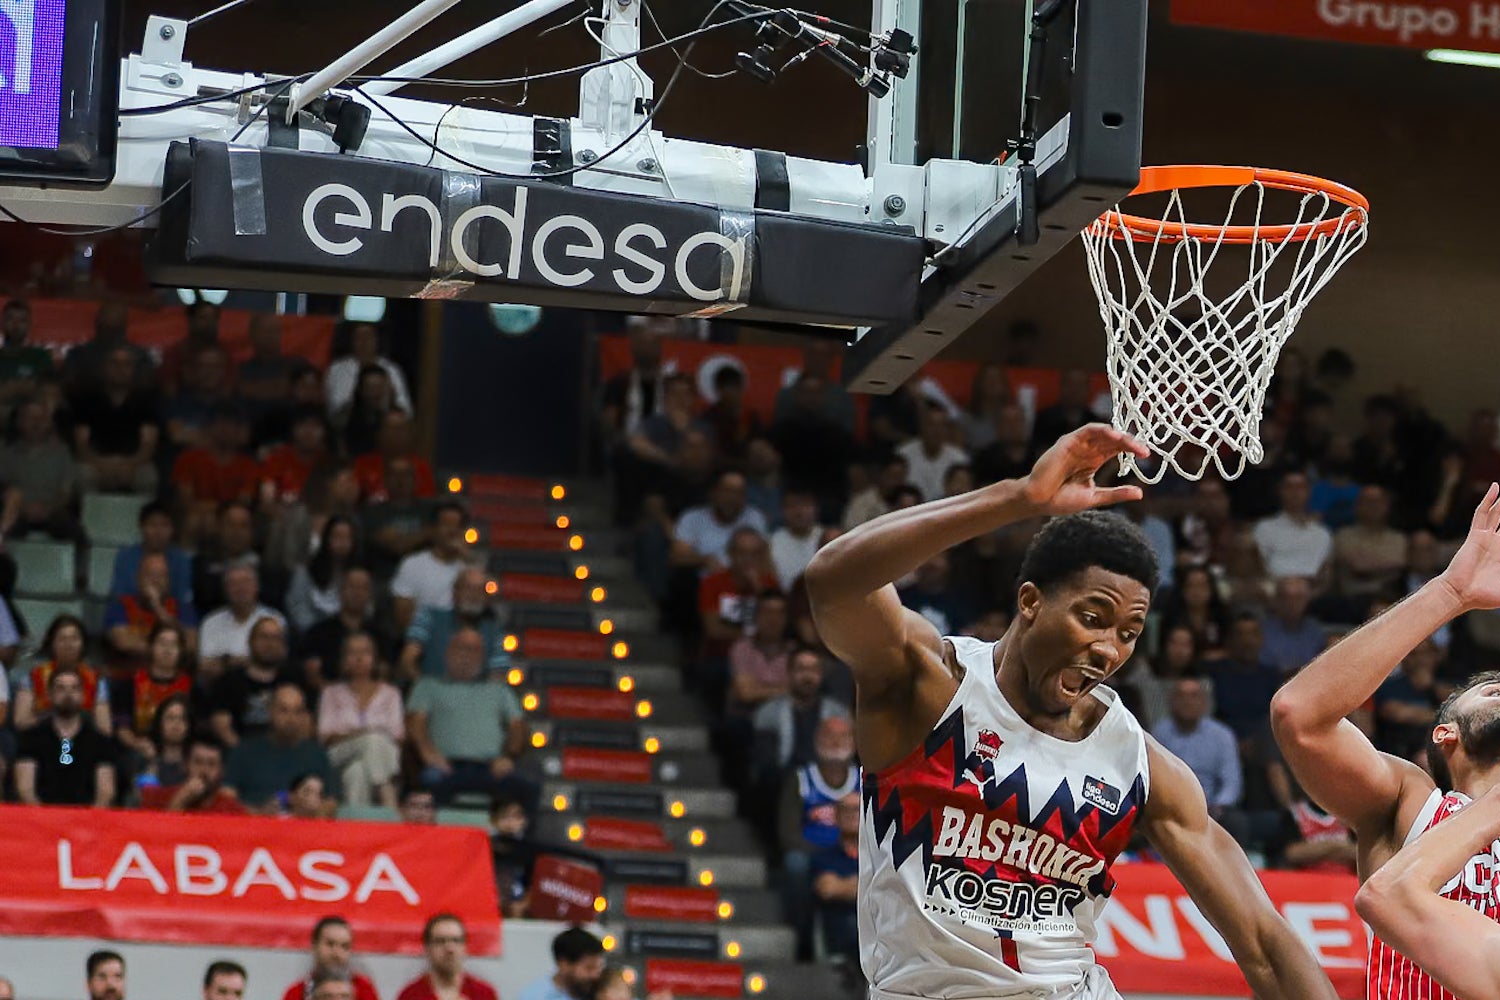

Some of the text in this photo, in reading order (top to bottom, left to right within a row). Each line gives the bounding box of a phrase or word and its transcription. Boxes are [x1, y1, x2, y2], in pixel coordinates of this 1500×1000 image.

[1317, 0, 1459, 43] Grupo
[302, 182, 747, 302] endesa
[57, 839, 420, 906] LABASA
